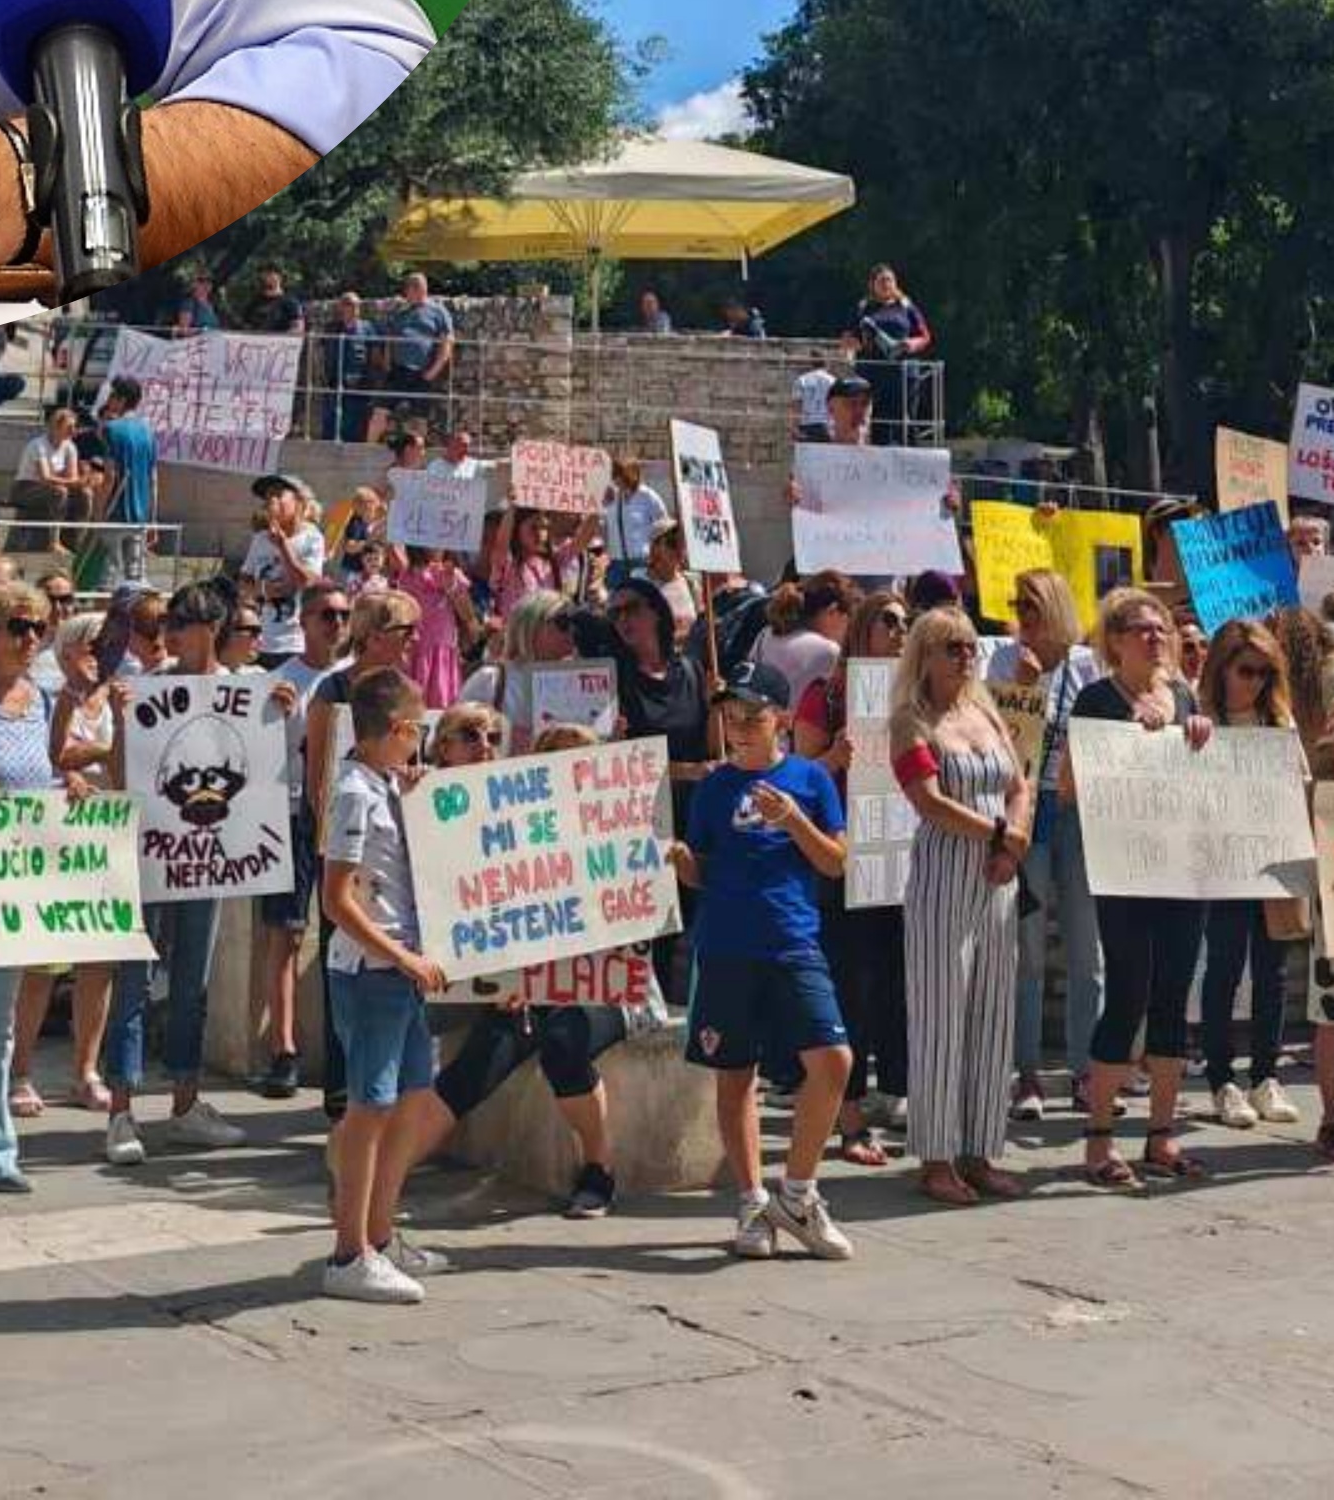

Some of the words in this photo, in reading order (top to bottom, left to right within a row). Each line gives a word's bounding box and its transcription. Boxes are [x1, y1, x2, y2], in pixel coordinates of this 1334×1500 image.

[134, 686, 192, 728] OVO
[212, 685, 252, 717] JE
[432, 782, 470, 822] OD
[487, 766, 553, 811] MOJE
[143, 827, 225, 862] PRAVA
[481, 819, 516, 858] MI
[527, 809, 558, 845] SE
[58, 841, 108, 873] SAM
[457, 850, 573, 911] NEMAM
[586, 841, 616, 881] NI
[626, 837, 660, 871] ZA
[0, 902, 21, 934] U
[451, 896, 585, 959] POŠTENE
